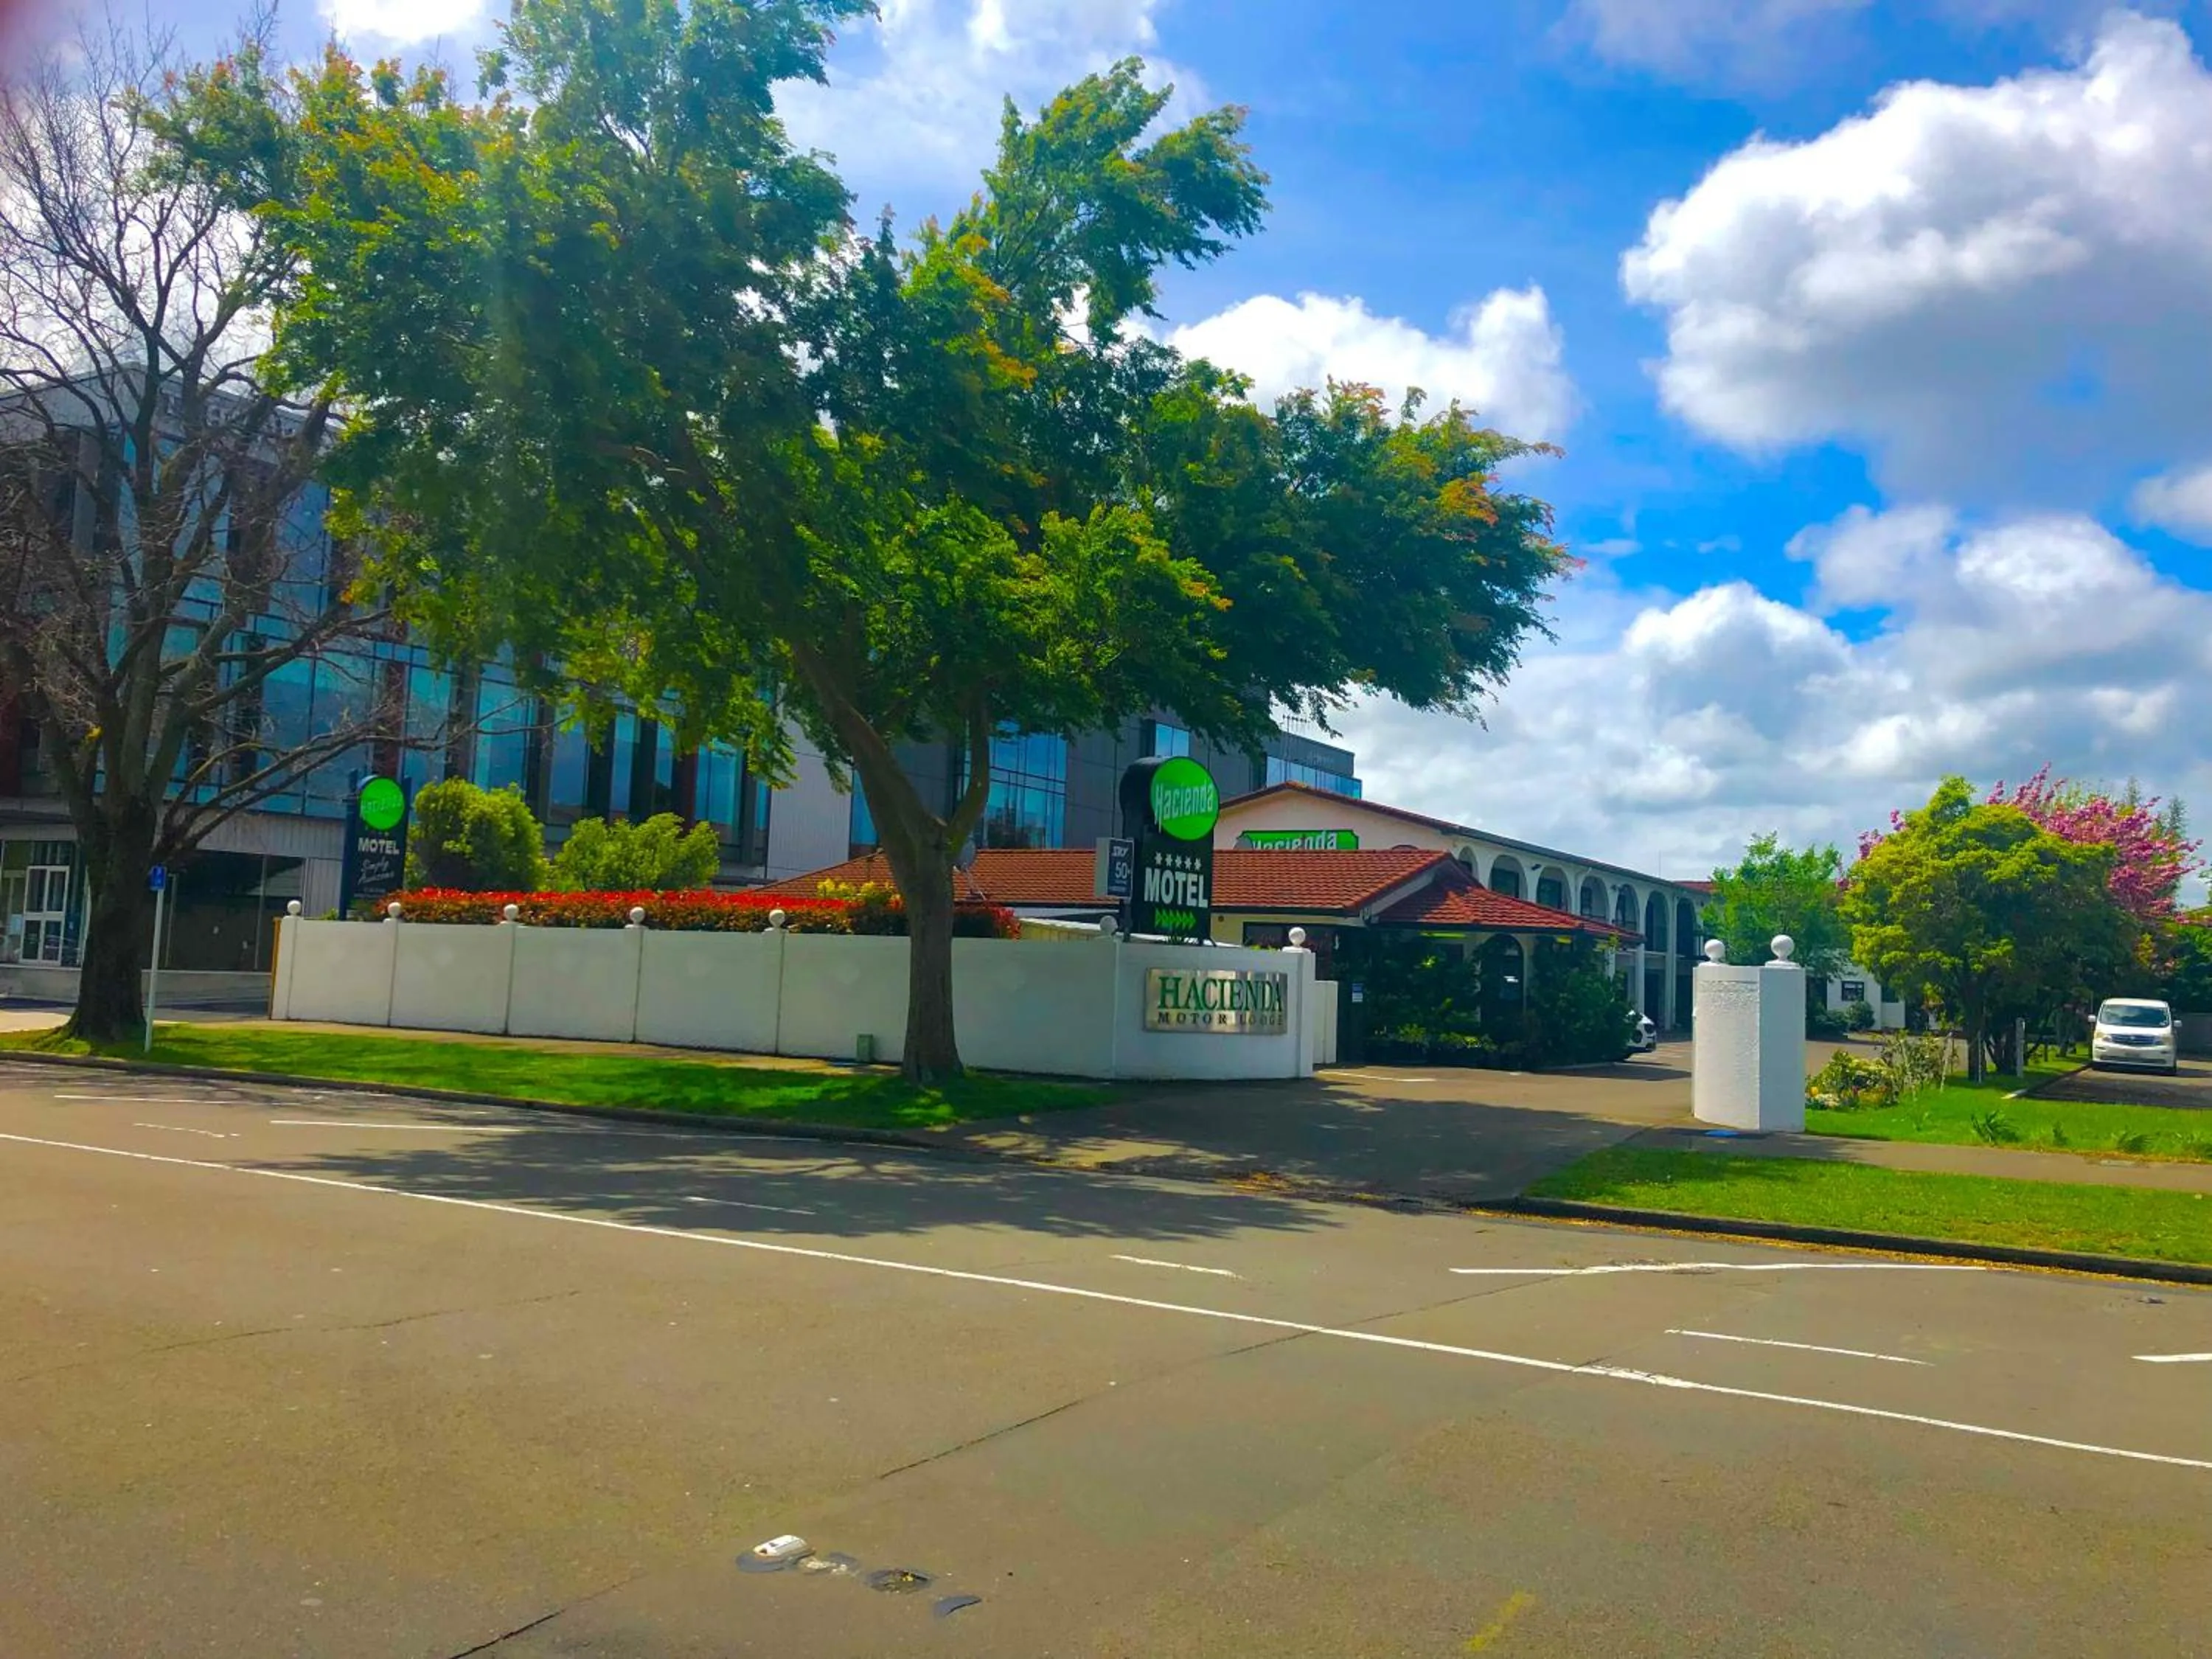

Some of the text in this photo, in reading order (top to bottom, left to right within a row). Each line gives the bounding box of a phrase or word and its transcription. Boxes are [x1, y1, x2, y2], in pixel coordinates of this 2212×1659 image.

[1155, 779, 1213, 834] Hacienda
[358, 837, 400, 855] MOTEL
[1144, 866, 1208, 908] MOTEL
[1158, 977, 1283, 1012] HACIENDA
[1158, 1012, 1284, 1026] MOTOR LODGE
